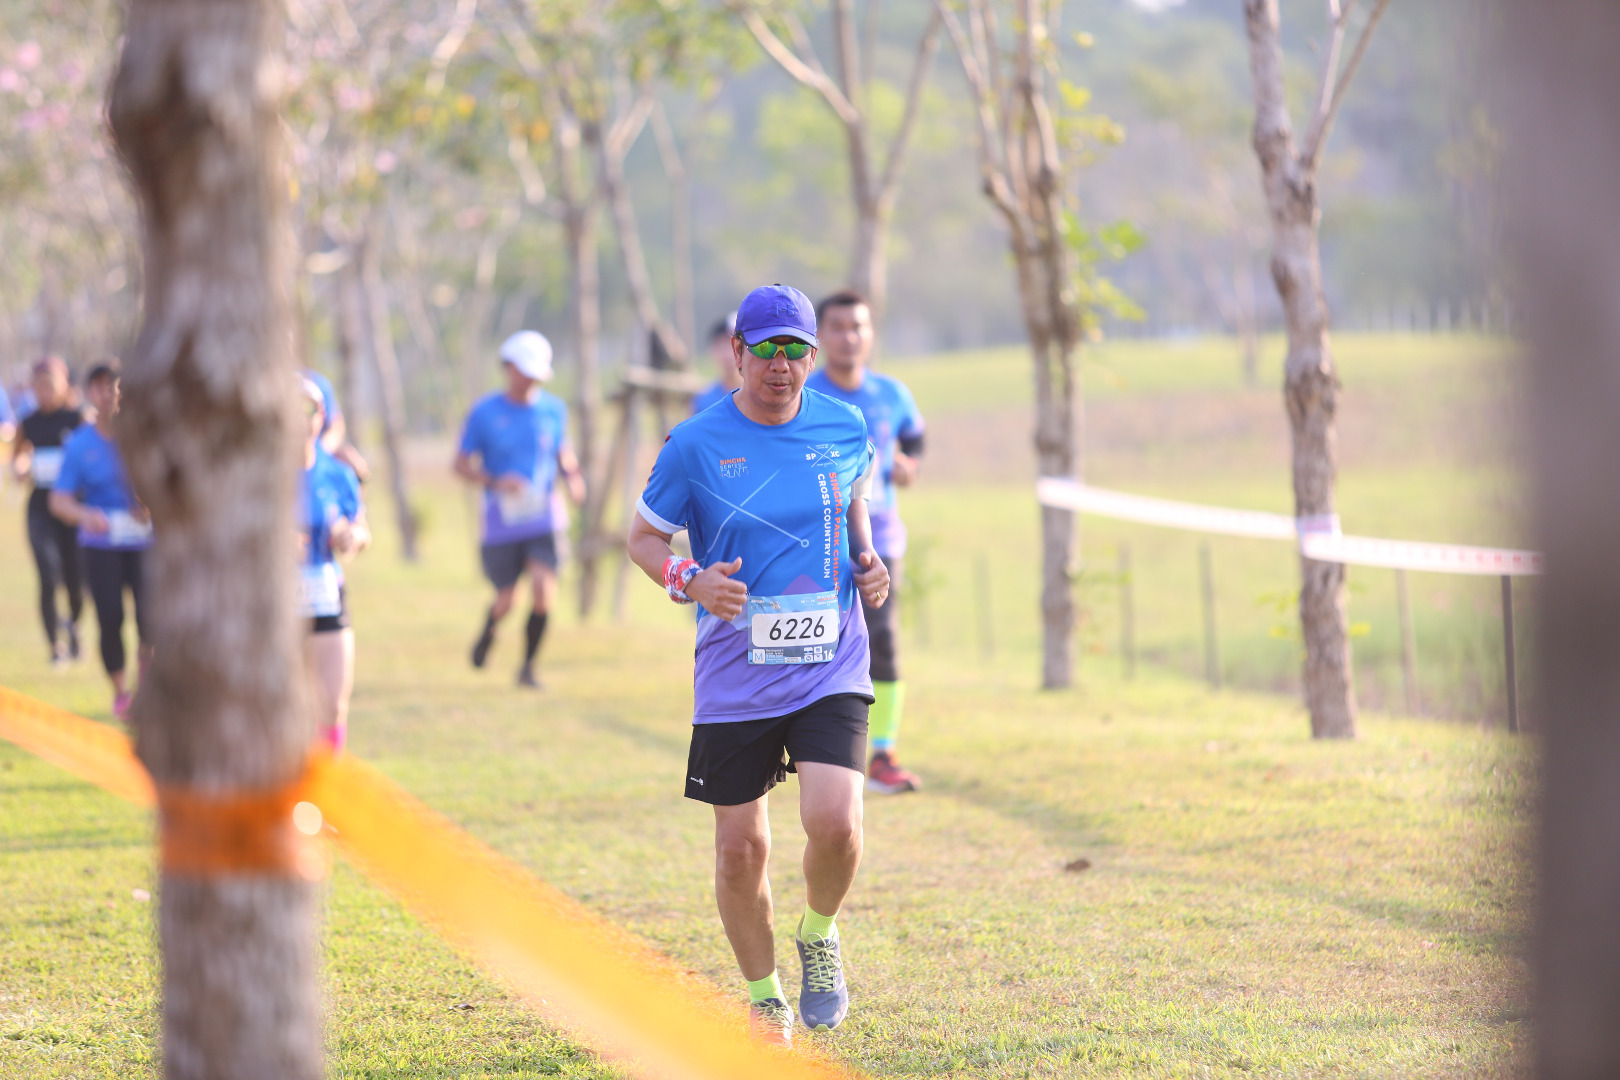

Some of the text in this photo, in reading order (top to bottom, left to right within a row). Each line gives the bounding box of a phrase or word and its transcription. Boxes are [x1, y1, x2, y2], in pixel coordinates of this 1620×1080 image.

[720, 456, 747, 466] SINGHA
[805, 450, 840, 461] SP XC
[817, 473, 831, 506] CROSS
[829, 472, 843, 515] SINGHA
[823, 507, 831, 556] COUNTRY
[823, 557, 831, 579] RUN
[769, 616, 825, 641] 6226
[754, 652, 763, 662] M
